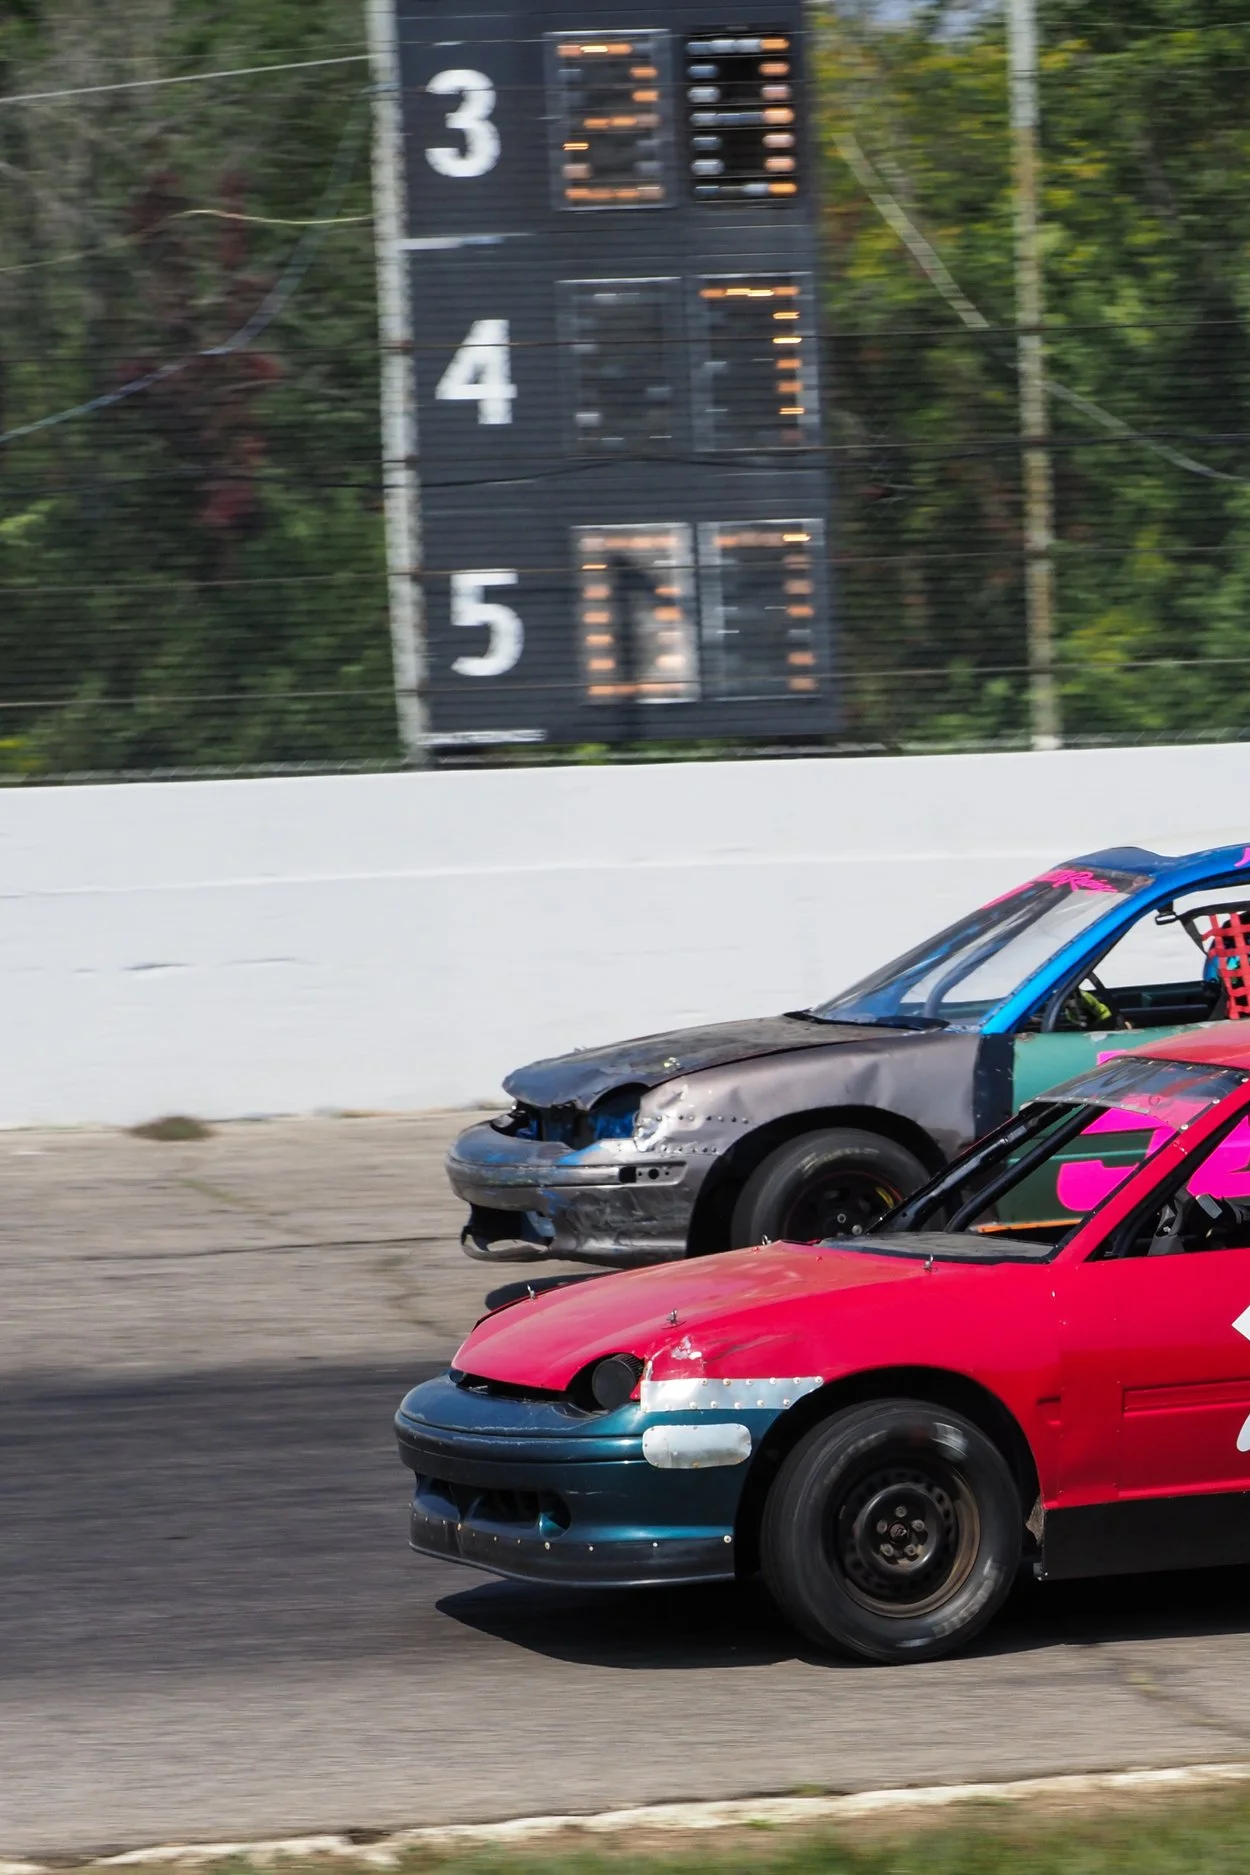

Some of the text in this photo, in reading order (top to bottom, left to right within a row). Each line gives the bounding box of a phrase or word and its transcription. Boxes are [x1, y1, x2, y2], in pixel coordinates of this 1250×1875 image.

[425, 69, 499, 178] 3
[435, 319, 518, 426] 4
[450, 569, 524, 677] 5
